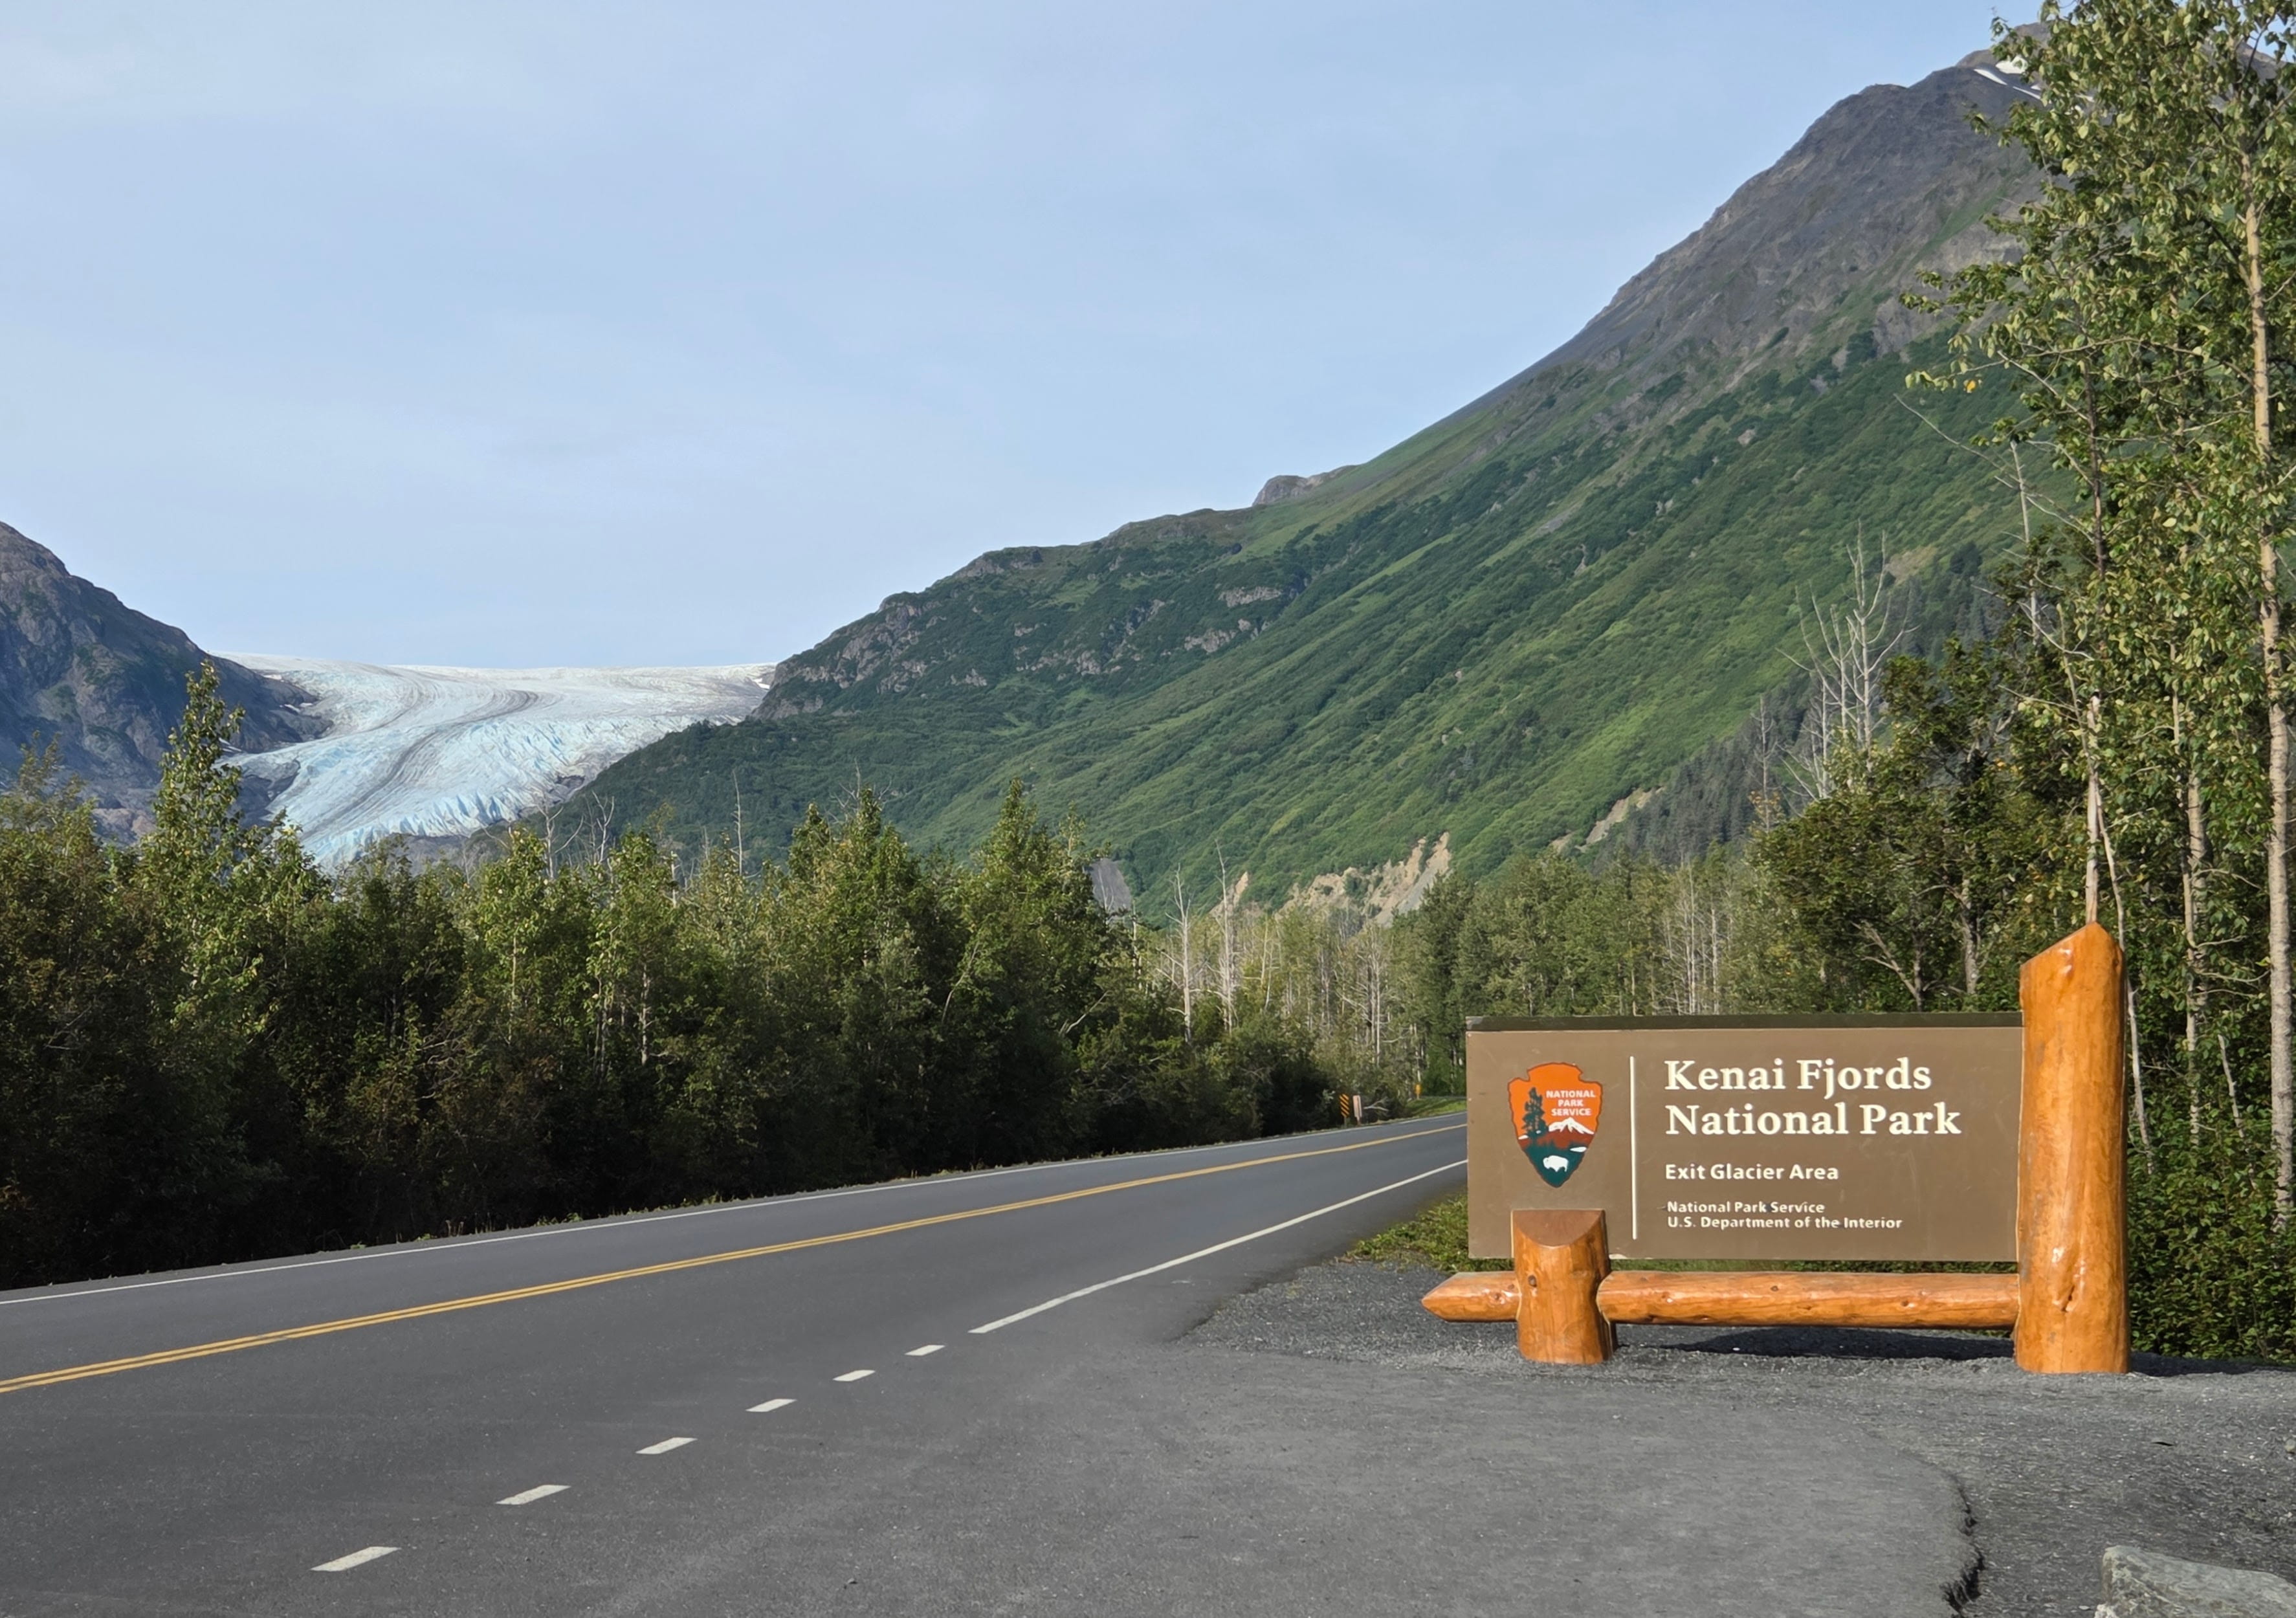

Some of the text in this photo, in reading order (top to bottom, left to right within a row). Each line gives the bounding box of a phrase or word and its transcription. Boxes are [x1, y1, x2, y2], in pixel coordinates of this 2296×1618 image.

[1664, 1057, 1931, 1099] Kenai Fjords
[1546, 1090, 1595, 1098] NATIONAL
[1558, 1099, 1584, 1107] PARK
[1552, 1108, 1591, 1116] SERVICE
[1666, 1102, 1961, 1135] National Park
[1666, 1164, 1838, 1179] Exit Glacier Area
[1668, 1201, 1825, 1212] National Park Service
[1668, 1217, 1902, 1230] U.S. Department of the Interior
